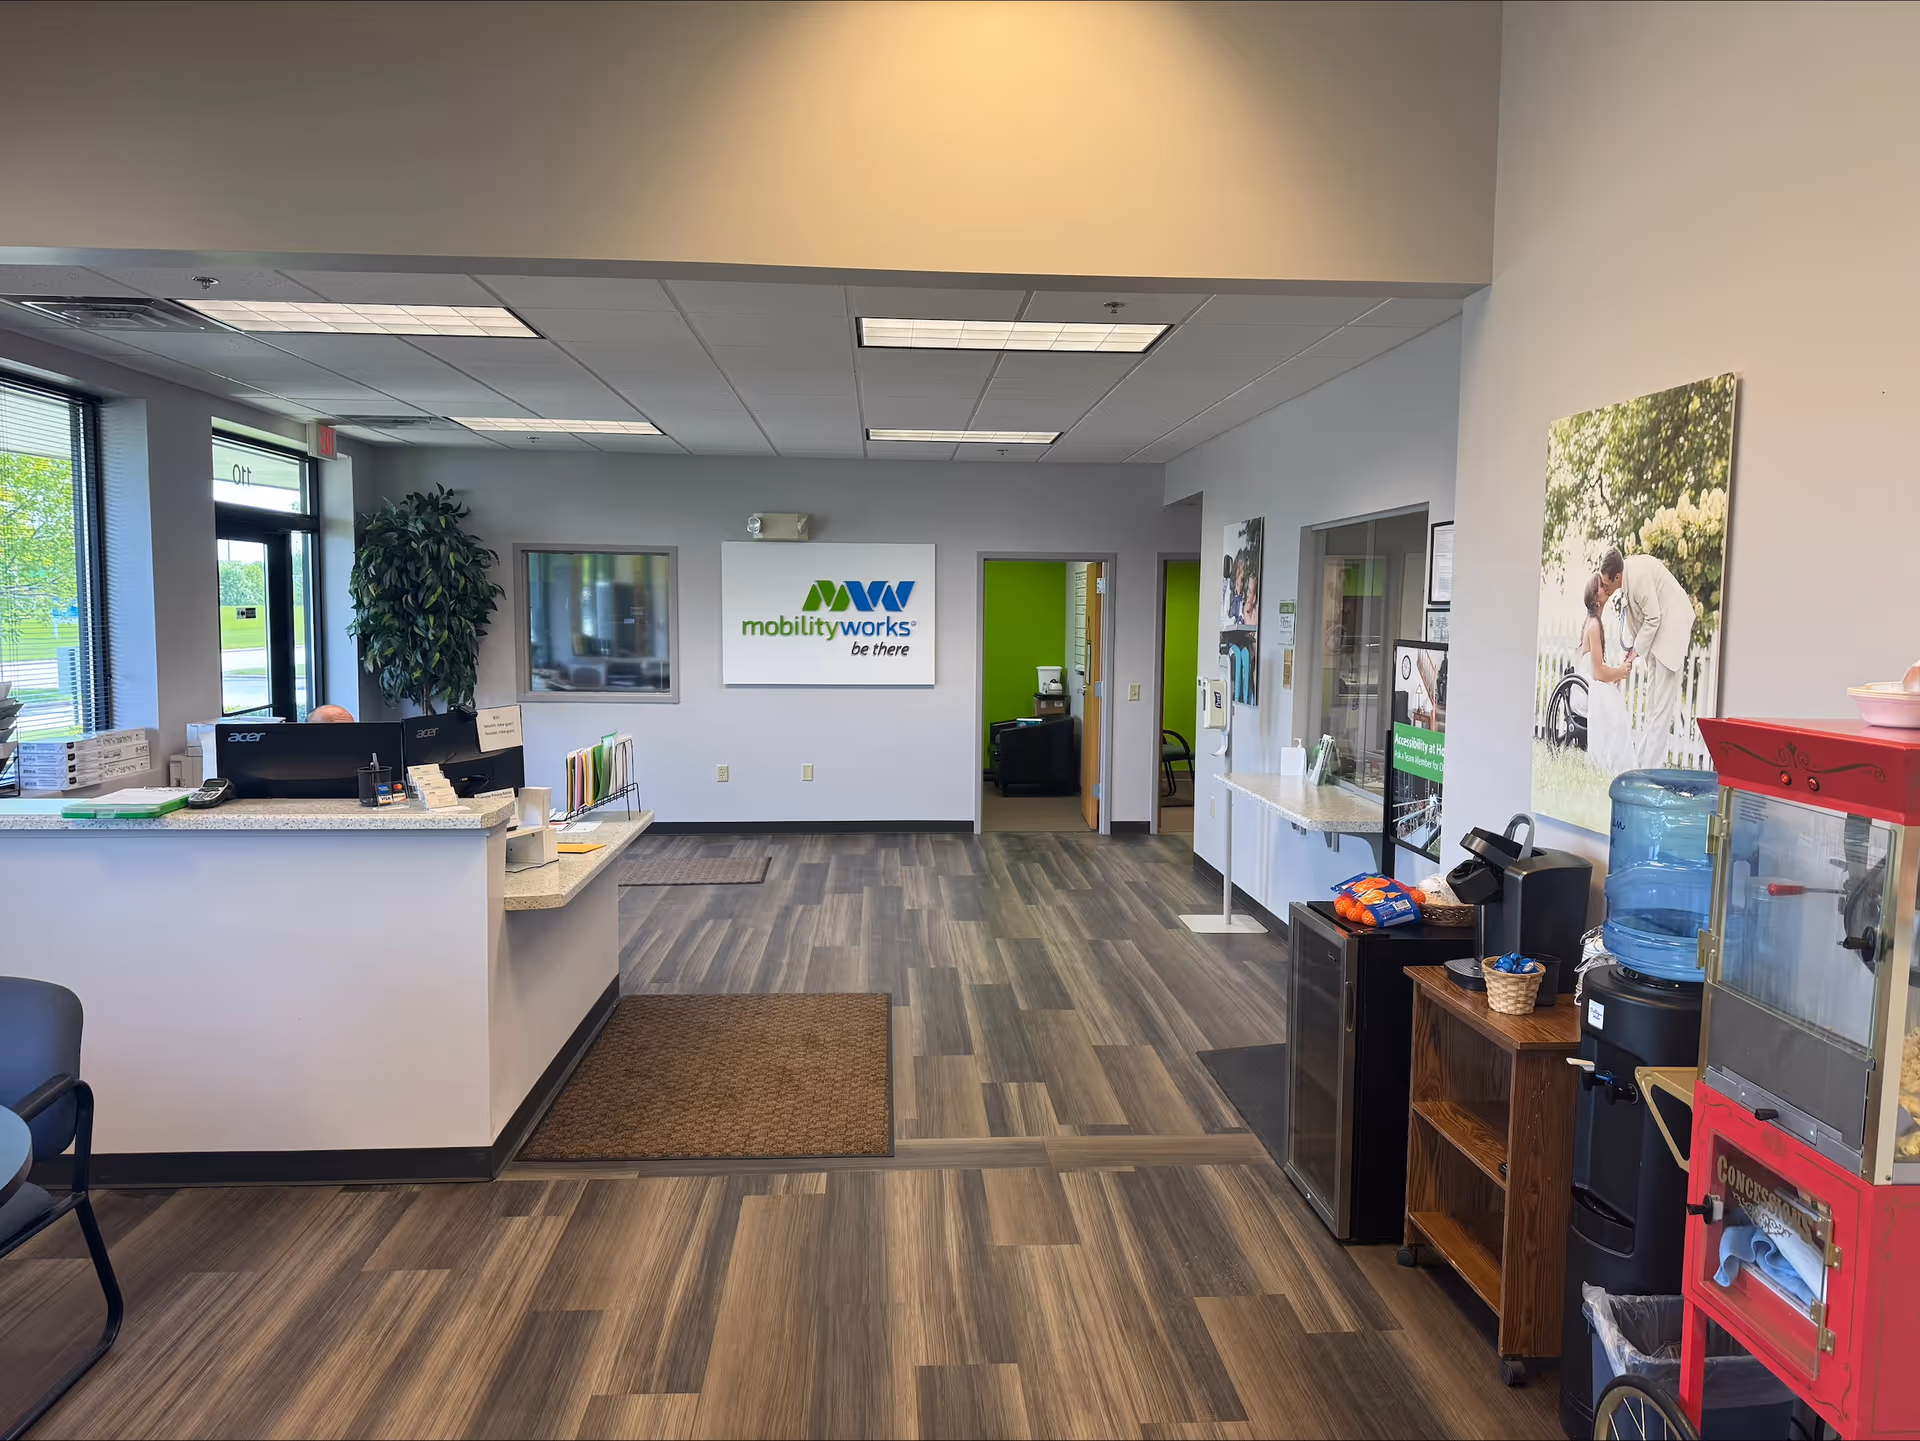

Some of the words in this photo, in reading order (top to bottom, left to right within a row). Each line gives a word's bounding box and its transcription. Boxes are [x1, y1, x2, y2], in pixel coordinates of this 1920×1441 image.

[851, 641, 869, 657] be
[872, 641, 910, 657] there
[227, 732, 266, 743] acer
[416, 727, 440, 739] acer
[1394, 732, 1428, 755] Accessibility
[1428, 743, 1436, 755] at
[1717, 1154, 1813, 1244] CONCESSIONS
